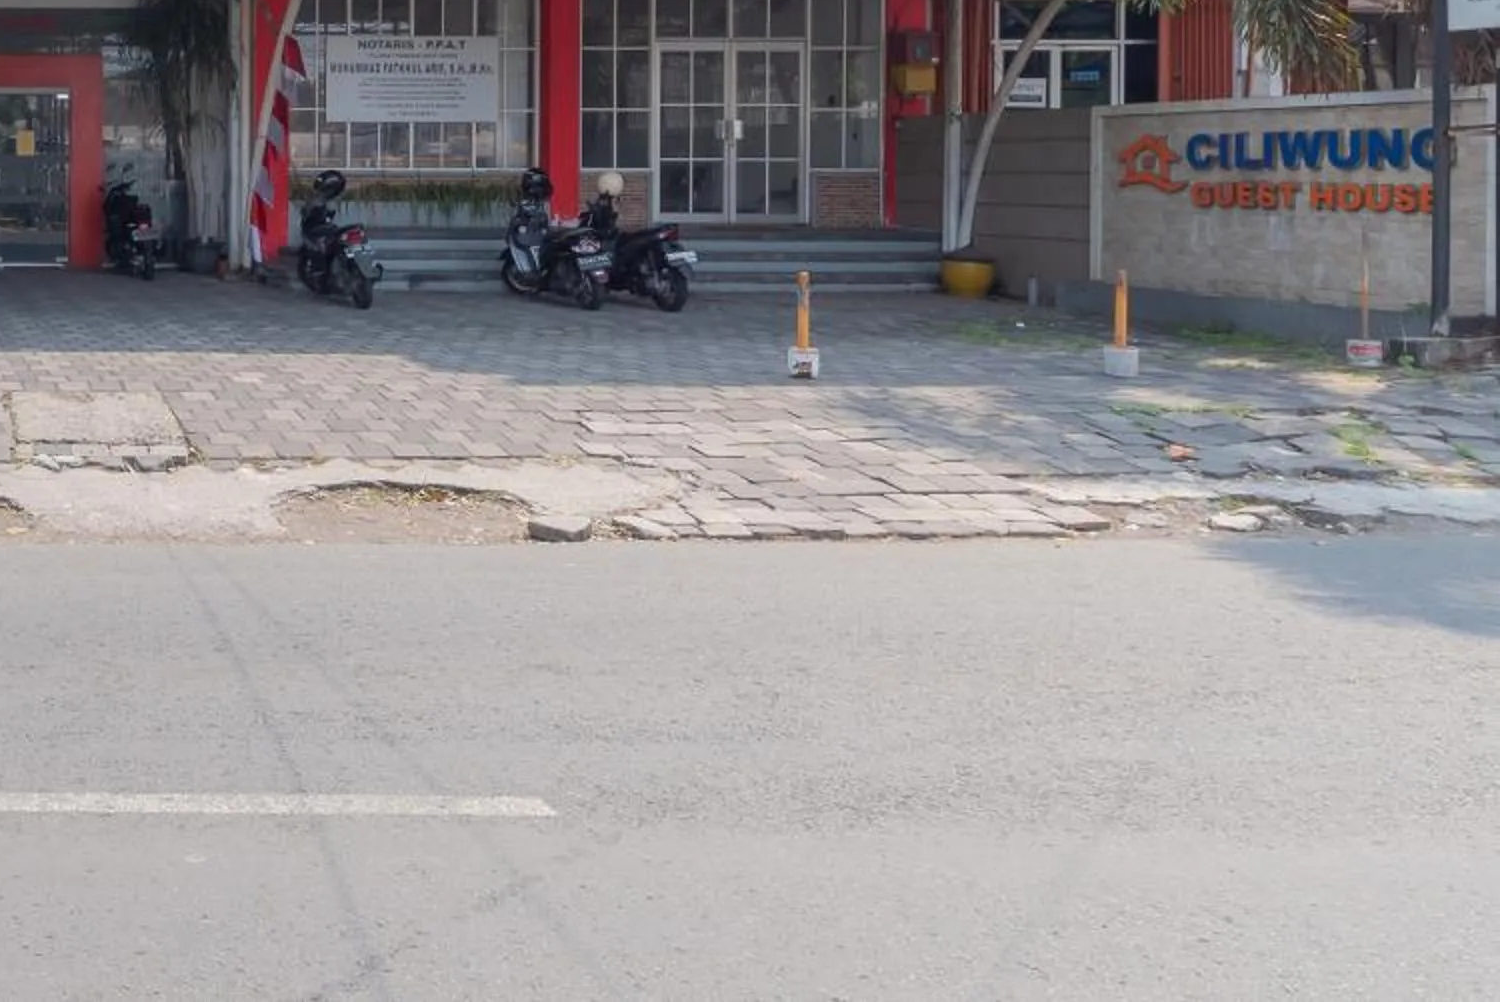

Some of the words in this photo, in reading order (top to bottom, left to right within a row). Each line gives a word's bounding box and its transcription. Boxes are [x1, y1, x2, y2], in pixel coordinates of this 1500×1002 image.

[357, 39, 415, 50] NOTARIS
[1187, 128, 1435, 172] CILIWUNG
[1190, 181, 1299, 210] GUEST
[1310, 181, 1435, 214] HOUSE
